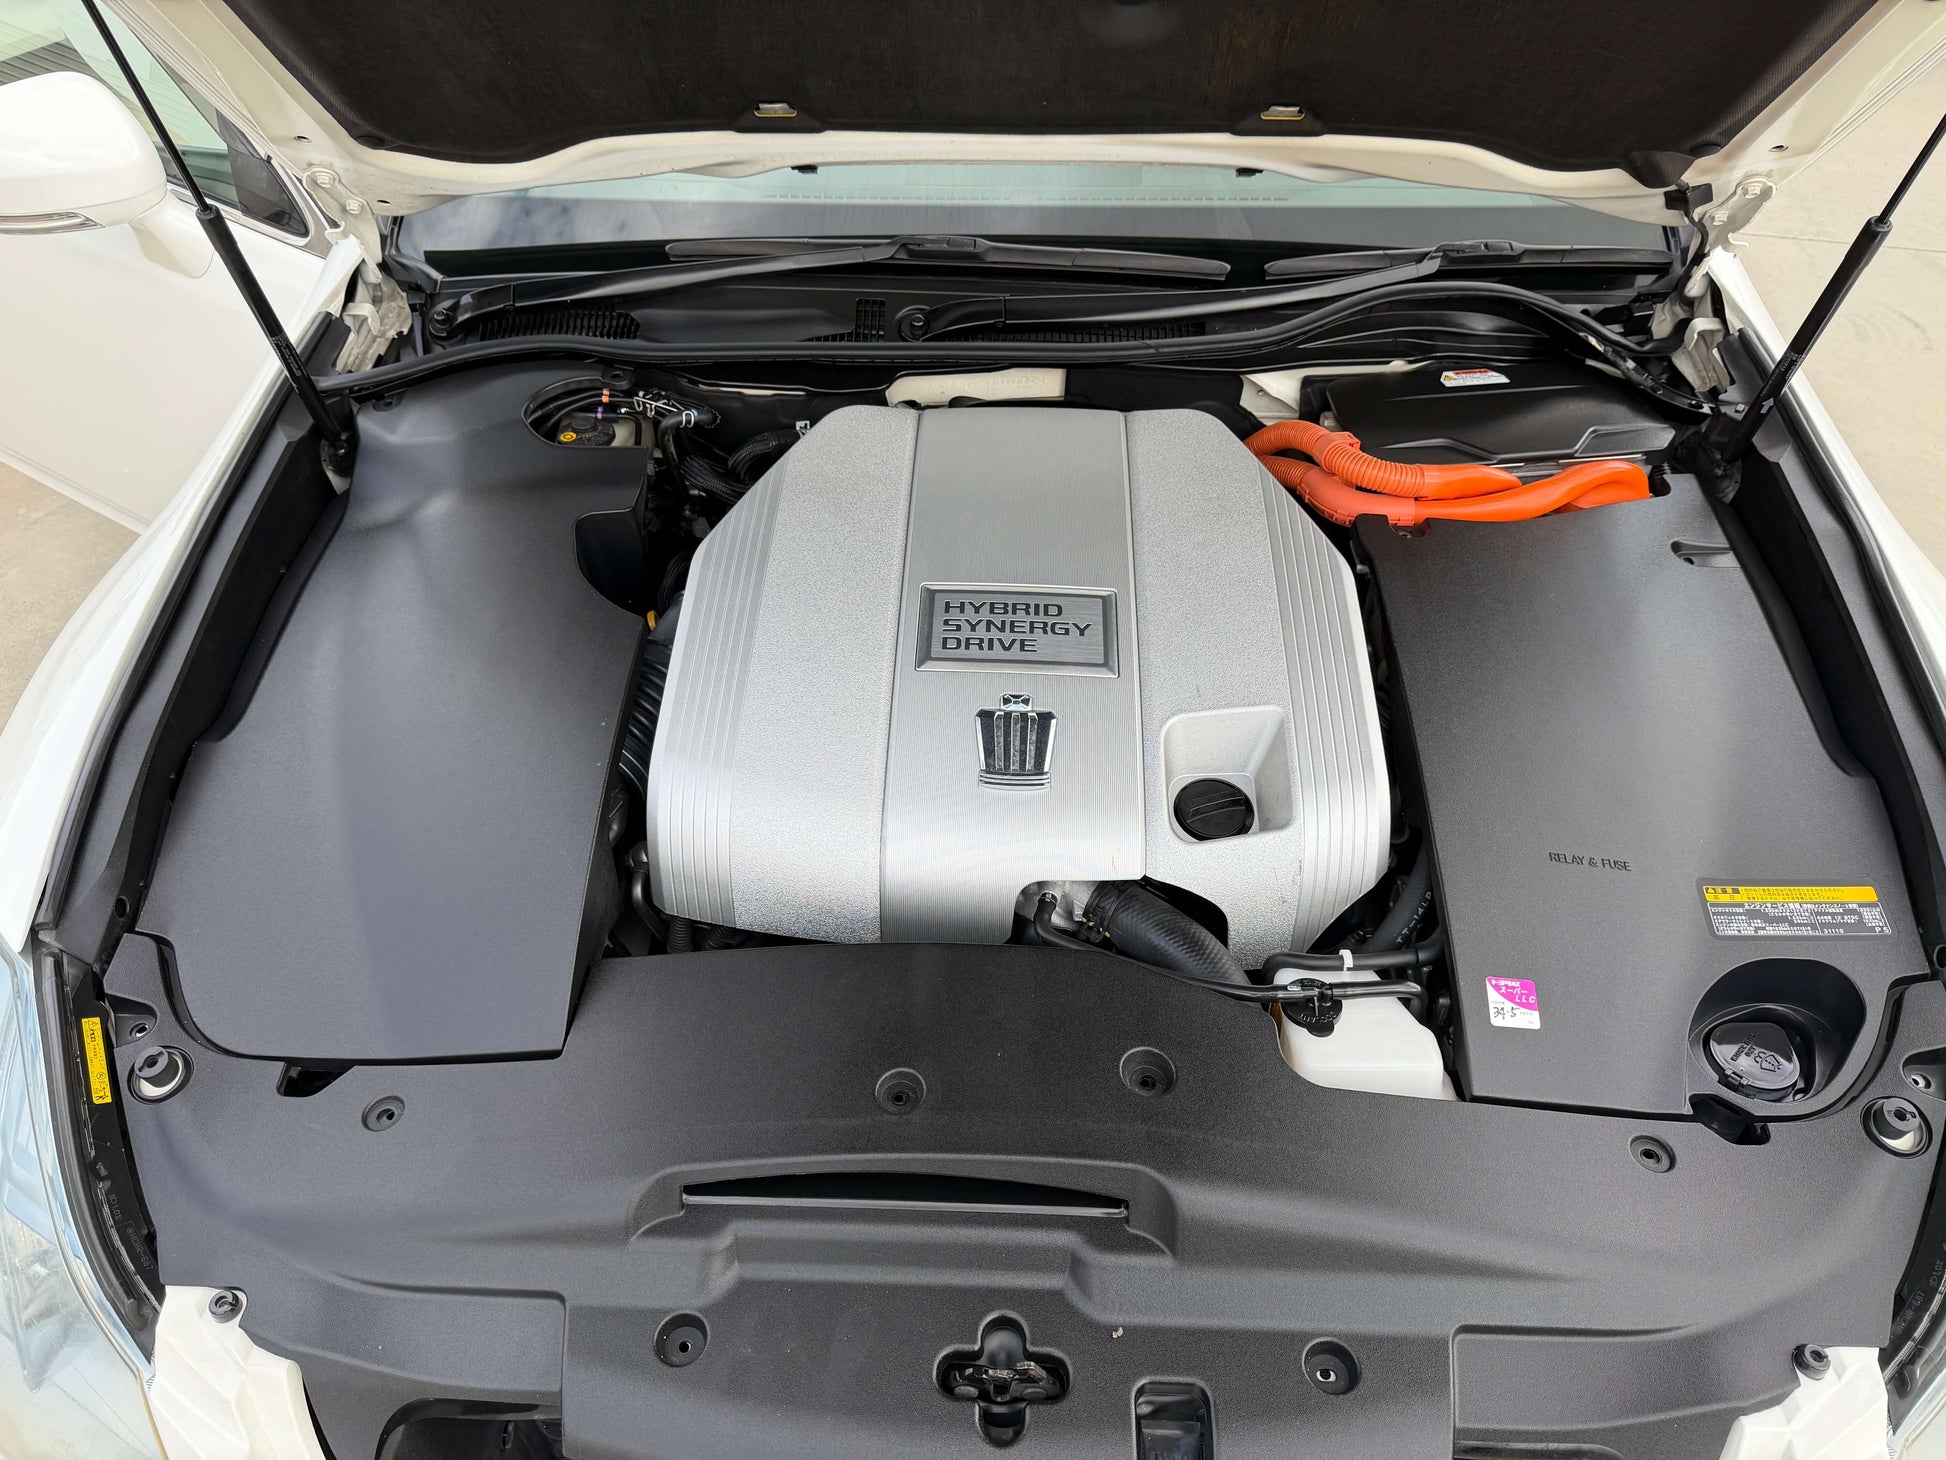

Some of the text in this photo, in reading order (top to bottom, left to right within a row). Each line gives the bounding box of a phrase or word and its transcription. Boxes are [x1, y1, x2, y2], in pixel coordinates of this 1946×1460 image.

[944, 600, 1063, 617] HYBRID
[942, 618, 1093, 637] SYNERGY
[941, 636, 1038, 652] DRIVE
[1548, 851, 1632, 872] RELAY & FUSE
[1515, 995, 1537, 1003] LLC
